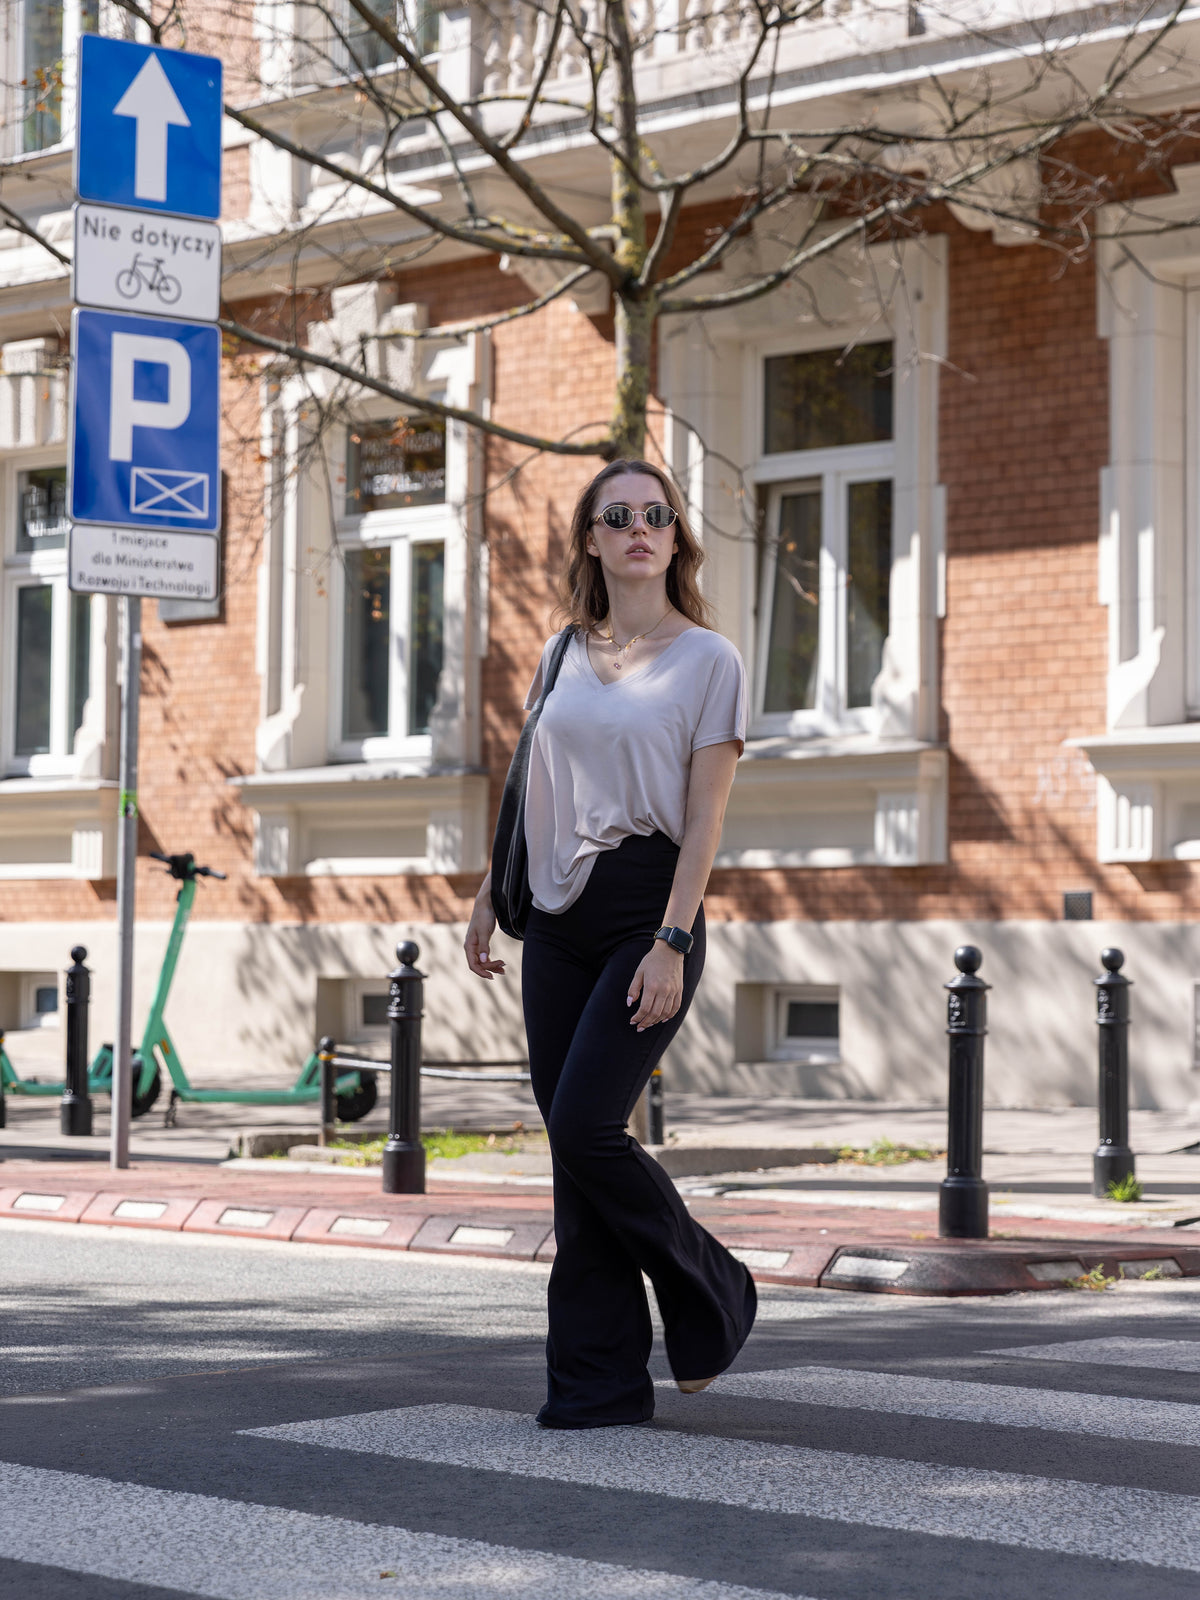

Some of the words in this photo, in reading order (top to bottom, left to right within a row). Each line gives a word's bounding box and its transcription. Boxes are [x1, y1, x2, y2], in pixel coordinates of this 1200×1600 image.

[83, 216, 120, 240] Nie
[131, 223, 215, 260] dotyczy
[109, 331, 191, 462] P
[120, 533, 168, 548] miejsce
[92, 552, 112, 565] dla
[116, 554, 194, 572] Ministerstwa
[79, 571, 130, 590] Rozwoju
[139, 576, 210, 596] Technologii
